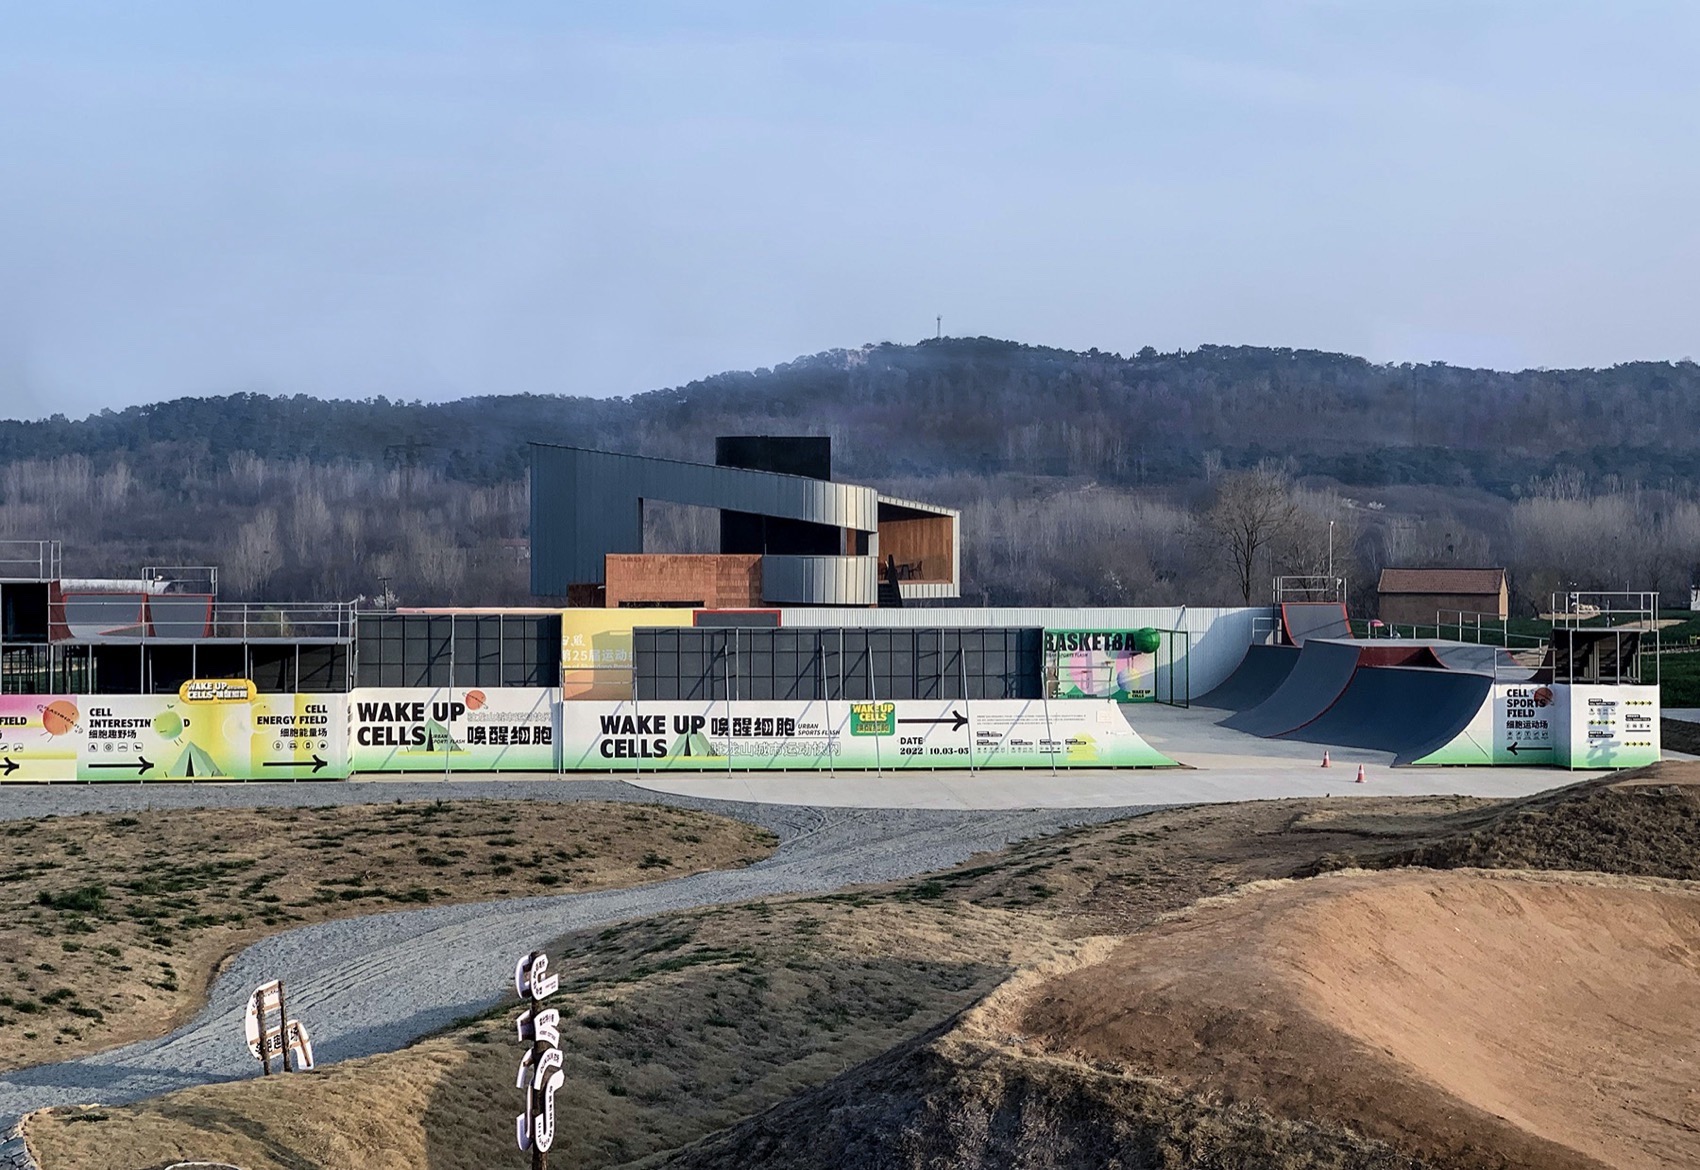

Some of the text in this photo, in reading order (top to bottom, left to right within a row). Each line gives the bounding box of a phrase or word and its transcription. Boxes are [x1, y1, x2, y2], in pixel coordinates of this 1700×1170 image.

[562, 648, 633, 662] 第25届运动
[188, 682, 213, 691] WAKE
[215, 682, 227, 691] UP
[188, 691, 213, 699] CELLS
[1506, 688, 1530, 698] CELL
[1506, 698, 1547, 708] SPORTS
[89, 708, 113, 717] CELL
[305, 704, 328, 714] CELL
[357, 702, 466, 722] WAKE UP
[853, 704, 894, 714] WAKE UP
[1506, 708, 1535, 718] FIELD
[0, 717, 27, 726] FIELD
[257, 716, 328, 725] ENERGY FIELD
[859, 713, 887, 722] CELLS
[89, 719, 151, 728] INTERESTIN
[600, 715, 706, 735] WAKE UP
[710, 717, 795, 737] 唤醒细胞
[1506, 720, 1549, 729] 细胞运动场
[88, 729, 137, 739] 细胞趣野场
[280, 728, 328, 737] 细胞能量场
[357, 726, 426, 746] CELLS
[467, 725, 553, 745] 唤醒细胞
[900, 737, 924, 745] DATE
[600, 739, 667, 758] CELLS
[900, 747, 924, 755] 2022
[929, 747, 970, 755] 10.03-05
